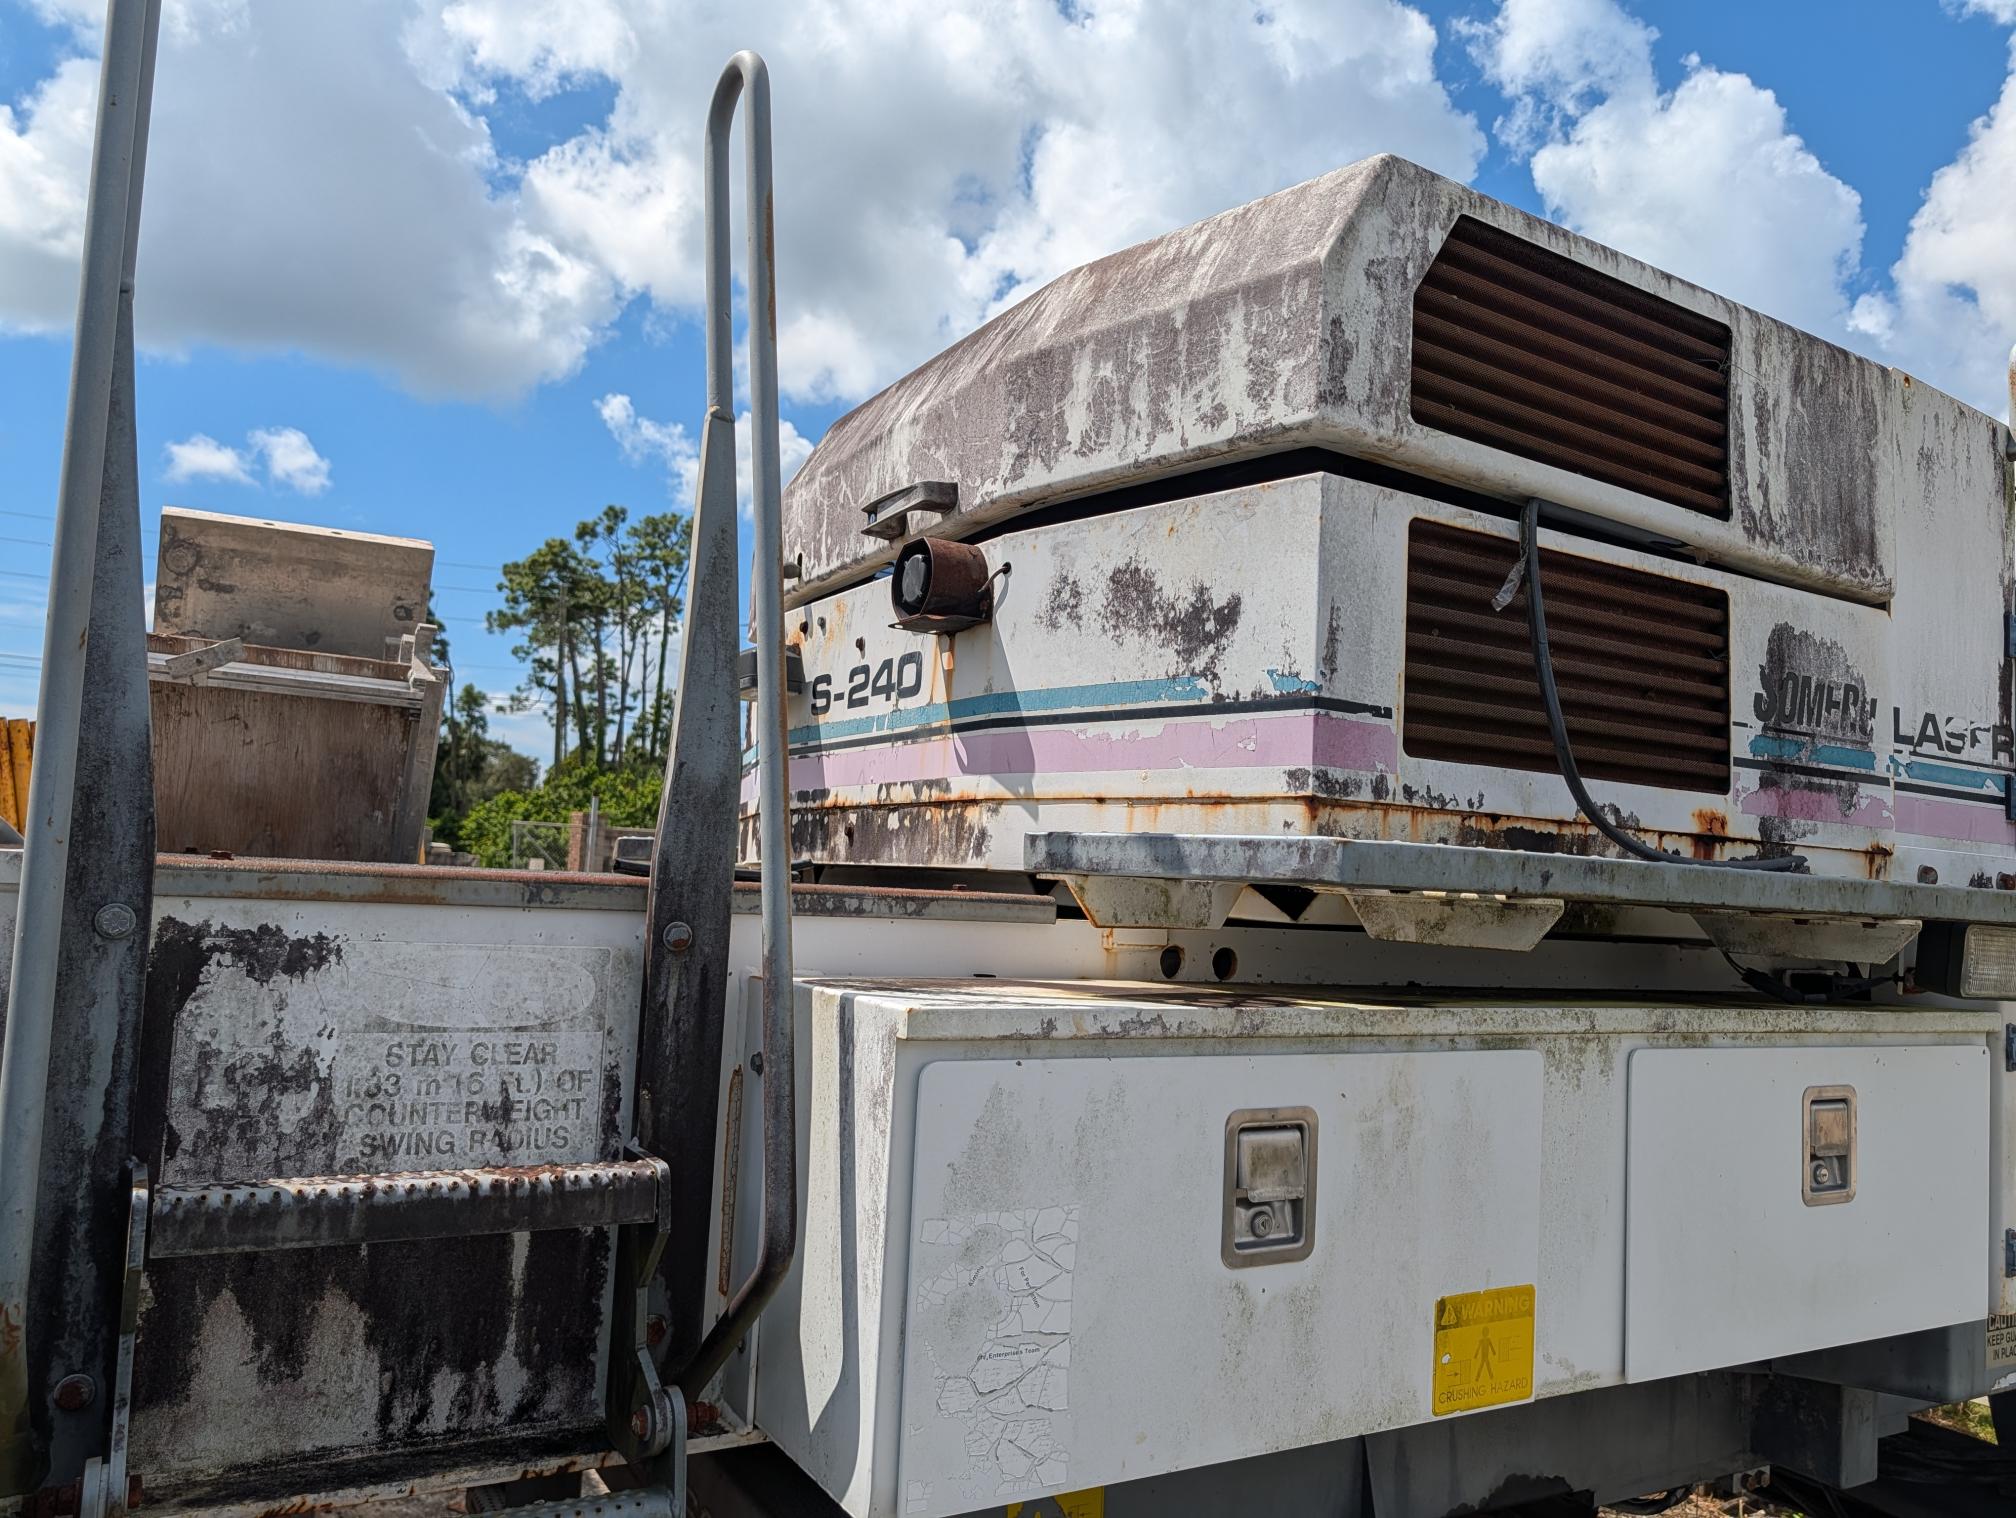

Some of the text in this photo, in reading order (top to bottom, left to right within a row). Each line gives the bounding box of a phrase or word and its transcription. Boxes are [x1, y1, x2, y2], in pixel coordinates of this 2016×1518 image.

[811, 651, 922, 716] S-240
[386, 1041, 560, 1068] STAY CLEAR
[416, 1077, 442, 1097] m
[556, 1068, 594, 1094] OF
[344, 1097, 588, 1128] COUNTERWEIGHT
[358, 1124, 570, 1158] SWING RADIUS
[1460, 1295, 1530, 1320] WARNING
[1987, 1332, 2004, 1347] KEEP
[1993, 1348, 2000, 1360] IN
[1439, 1377, 1529, 1404] CRUSHING HAZARD
